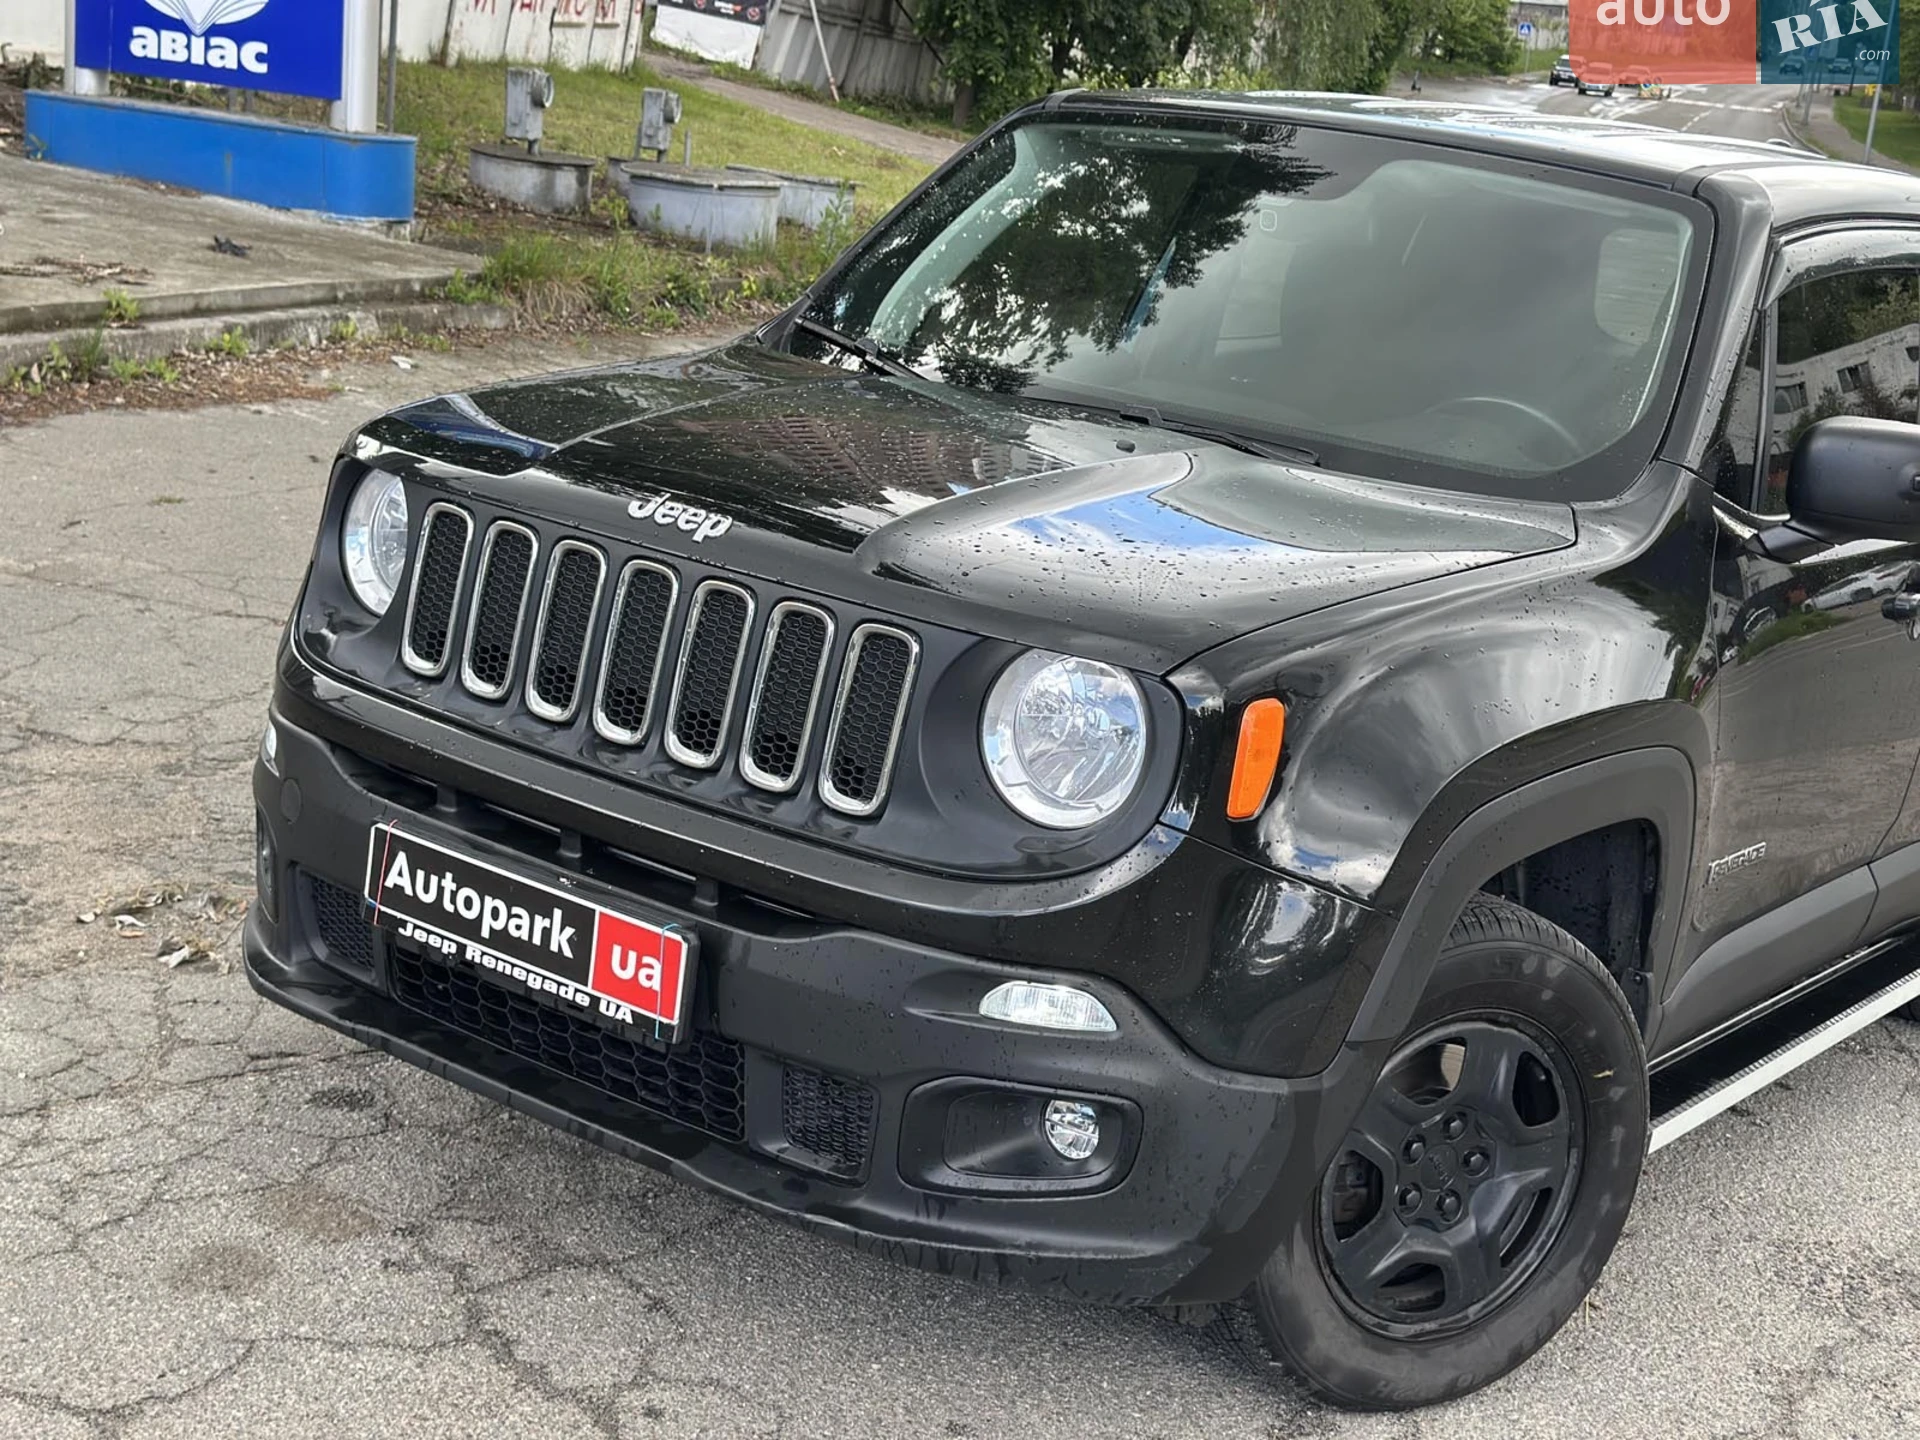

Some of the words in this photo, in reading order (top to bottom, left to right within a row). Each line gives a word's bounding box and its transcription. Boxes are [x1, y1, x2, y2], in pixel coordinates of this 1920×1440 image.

[628, 492, 732, 543] Jeep
[384, 850, 576, 959] Autopark
[611, 943, 662, 992] ua
[398, 922, 457, 955] Jeep
[465, 944, 591, 1008] Renegade
[599, 998, 634, 1025] UA
